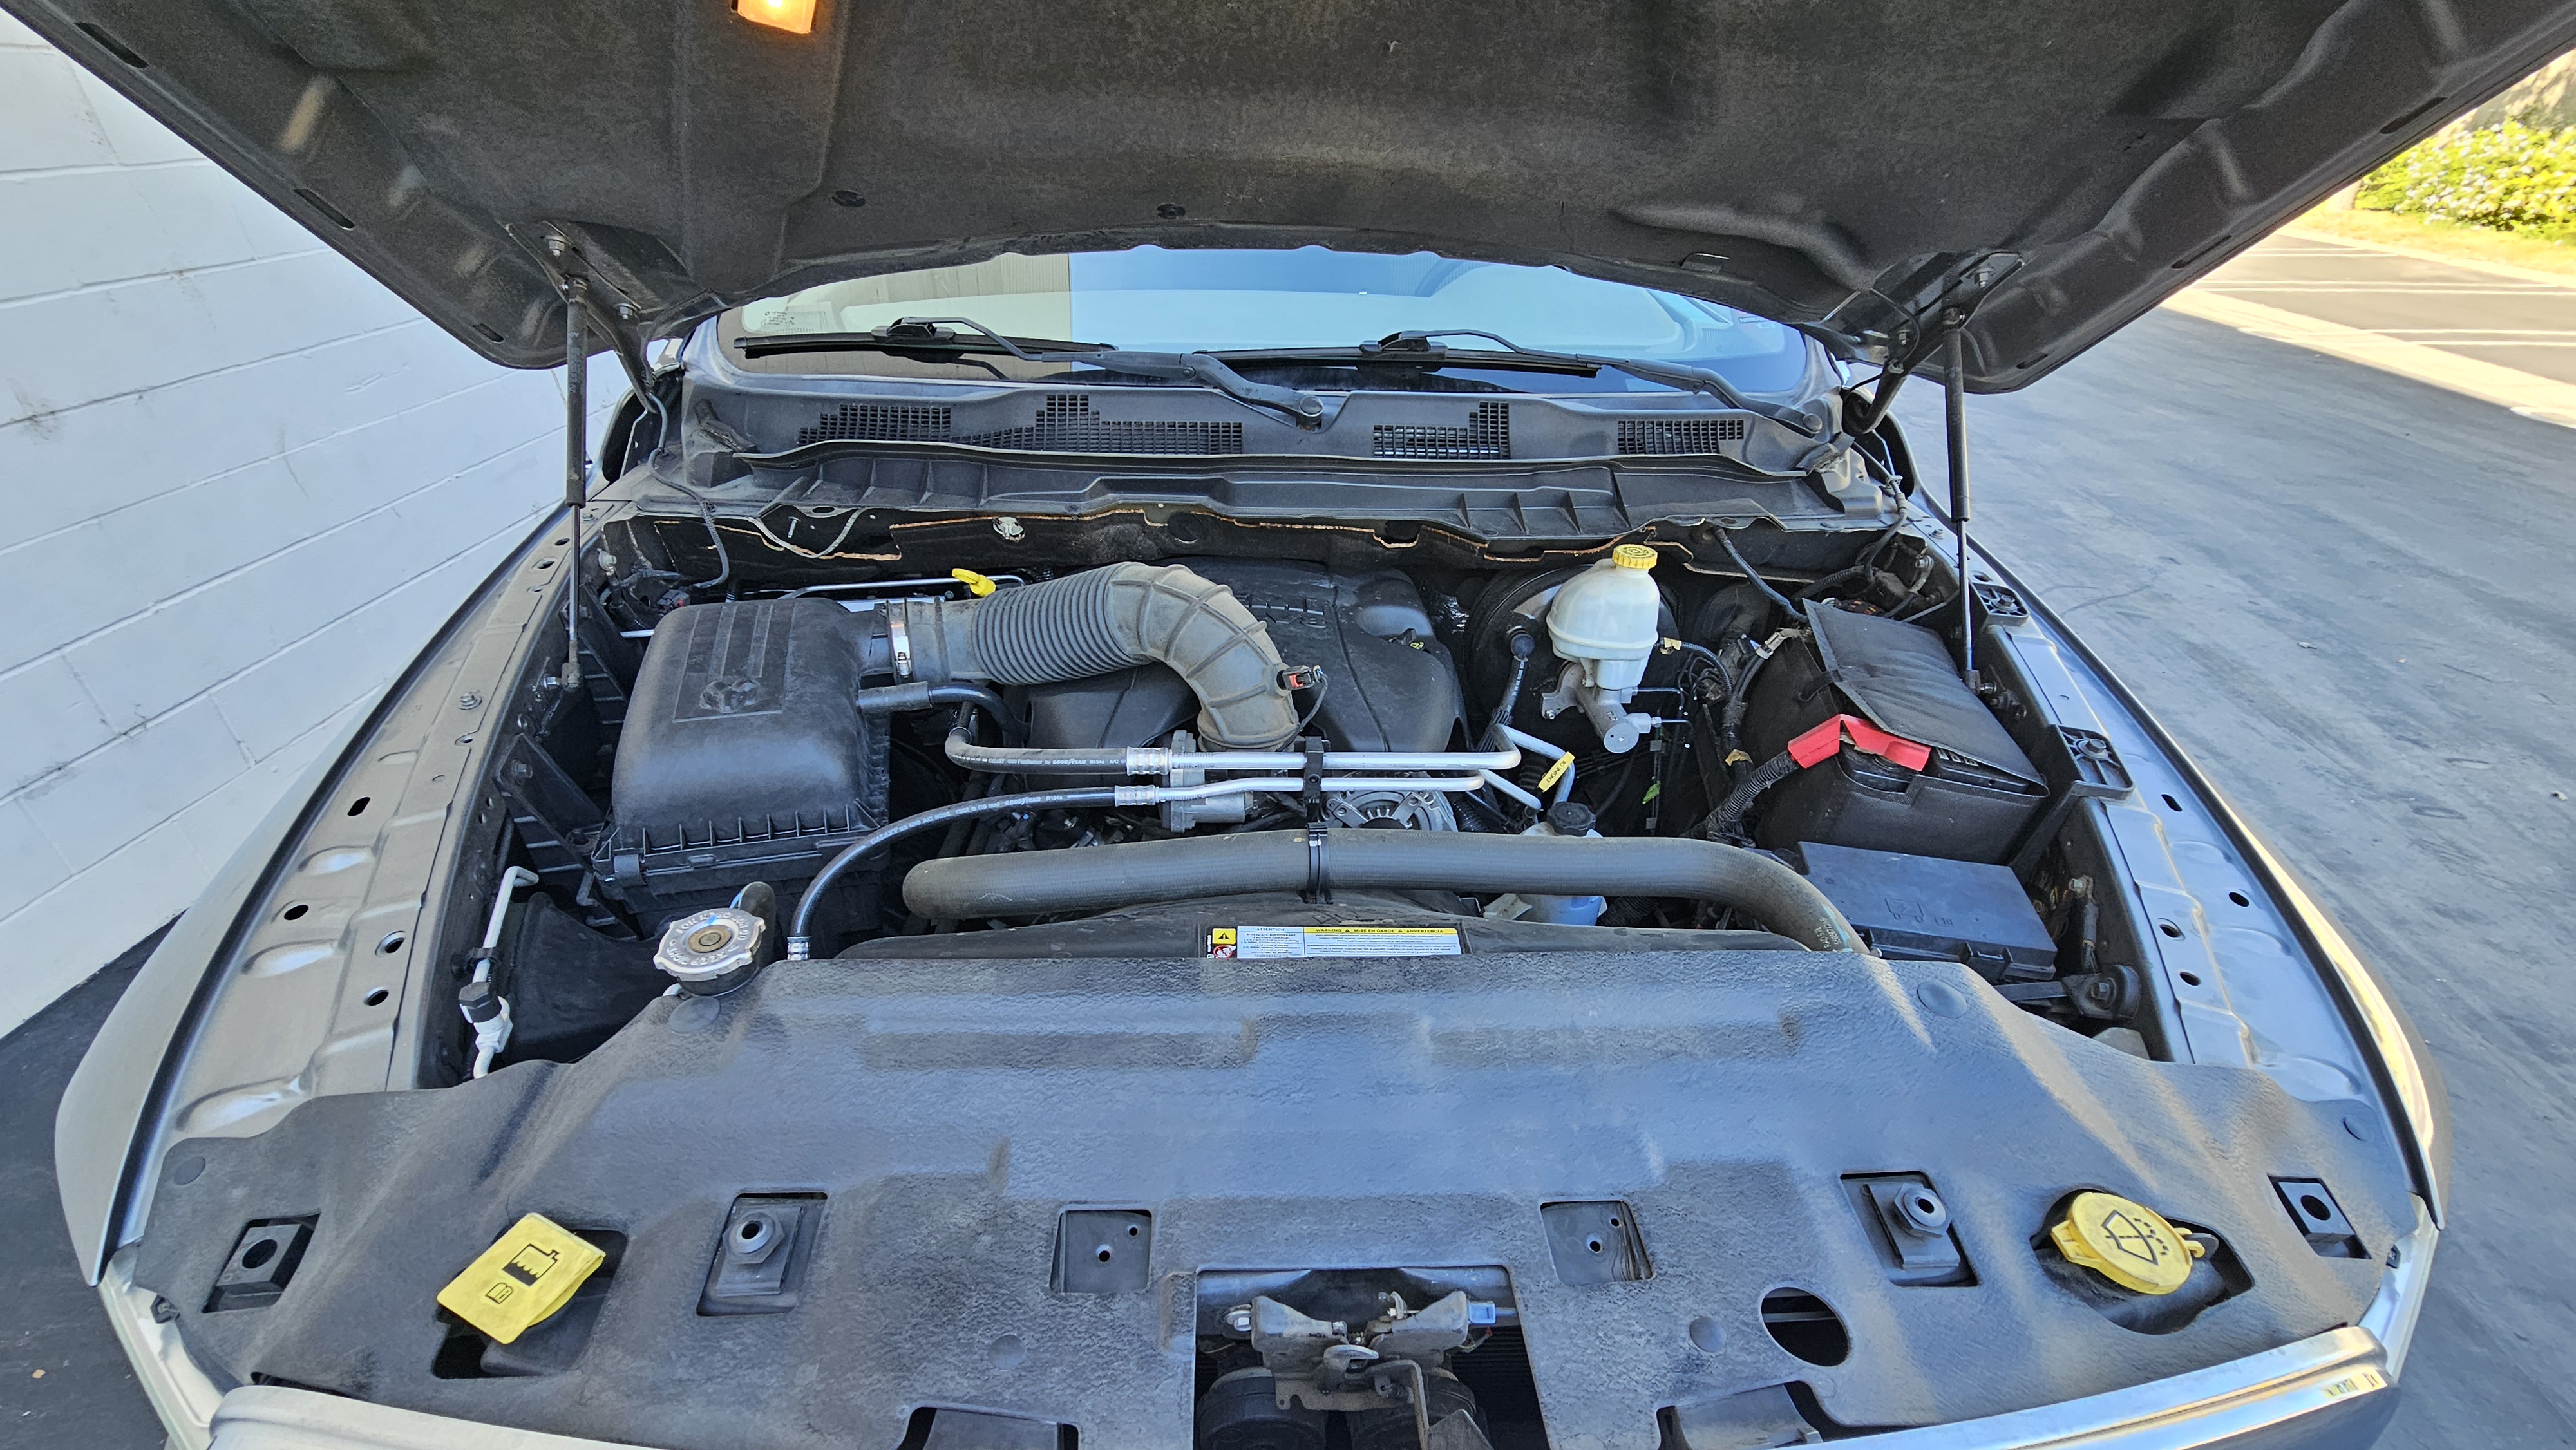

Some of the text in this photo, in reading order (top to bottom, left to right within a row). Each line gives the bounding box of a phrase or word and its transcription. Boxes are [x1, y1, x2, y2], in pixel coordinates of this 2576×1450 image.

[1546, 766, 1562, 783] ENGINE
[870, 827, 898, 845] GALAXY
[934, 811, 951, 820] HOSE
[1005, 796, 1041, 805] GOODYEAR
